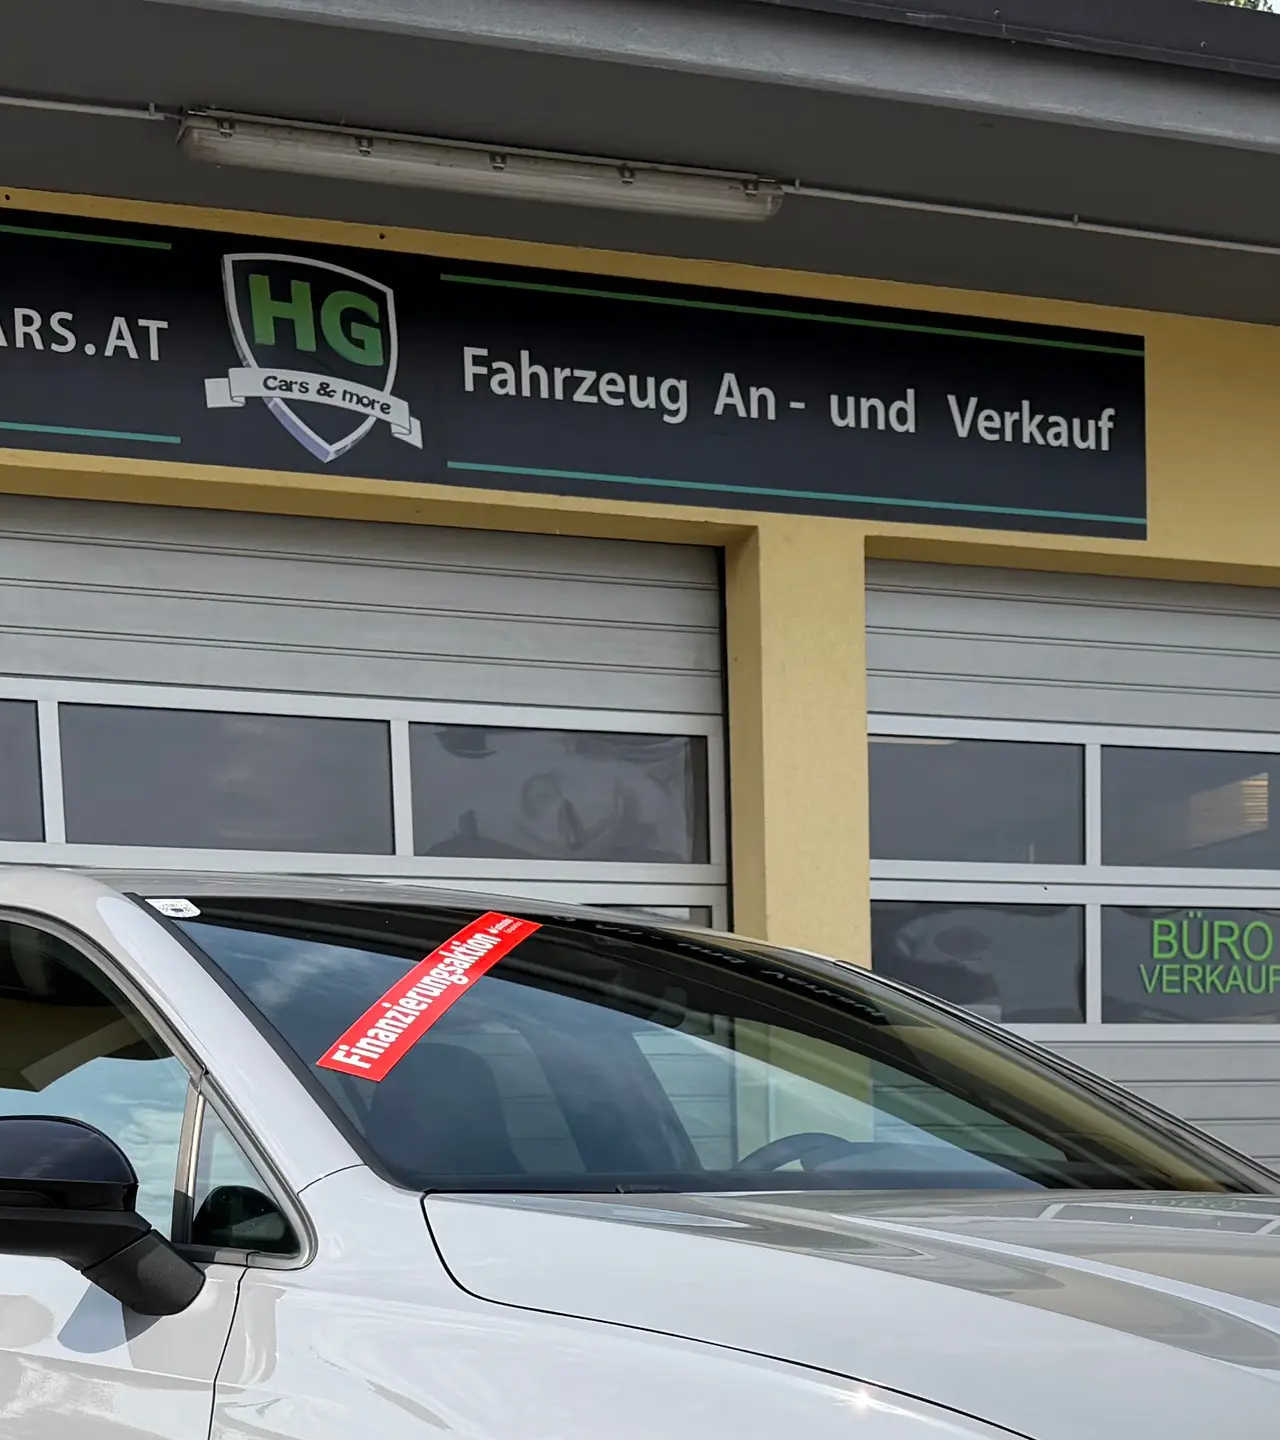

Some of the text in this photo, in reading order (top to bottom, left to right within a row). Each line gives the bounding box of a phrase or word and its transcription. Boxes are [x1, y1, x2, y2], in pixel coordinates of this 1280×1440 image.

[249, 273, 383, 367] HG
[263, 375, 391, 415] Cars & more
[462, 346, 688, 426] Fahrzeug
[829, 390, 917, 434] und
[947, 396, 1116, 453] Verkauf
[1152, 911, 1273, 962] BÜRO
[331, 932, 502, 1070] Finanzierungsaktion
